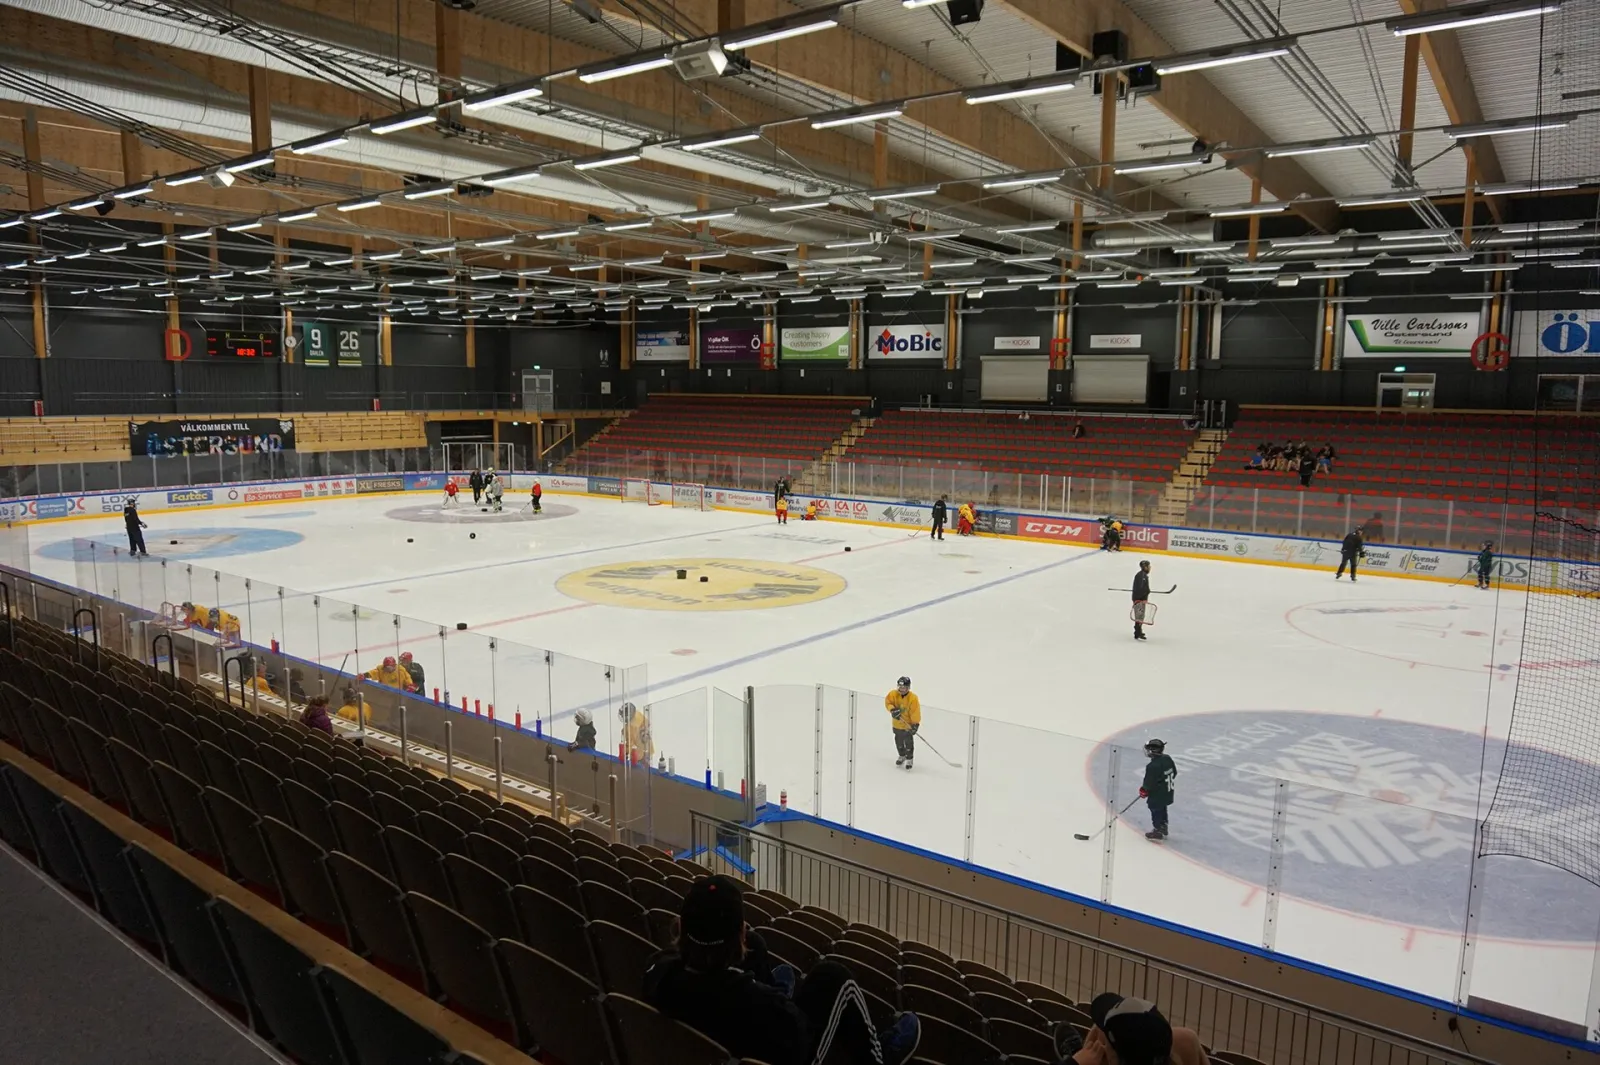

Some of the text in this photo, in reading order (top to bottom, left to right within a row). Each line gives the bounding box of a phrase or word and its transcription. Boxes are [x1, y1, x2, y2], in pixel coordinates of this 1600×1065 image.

[1371, 318, 1468, 330] Ville Carlssons
[310, 328, 322, 349] 9
[340, 330, 359, 350] 26
[877, 330, 942, 352] MoBic
[1109, 337, 1131, 345] KIOSK
[180, 422, 250, 432] VÄLKOMMEN TILL
[101, 494, 141, 504] LOXY
[1025, 522, 1083, 536] CCM
[1099, 526, 1160, 543] Sandic
[1170, 540, 1229, 552] BERNERS
[1366, 558, 1388, 566] Cater
[1411, 554, 1440, 564] Svensk
[1414, 562, 1438, 572] Cater
